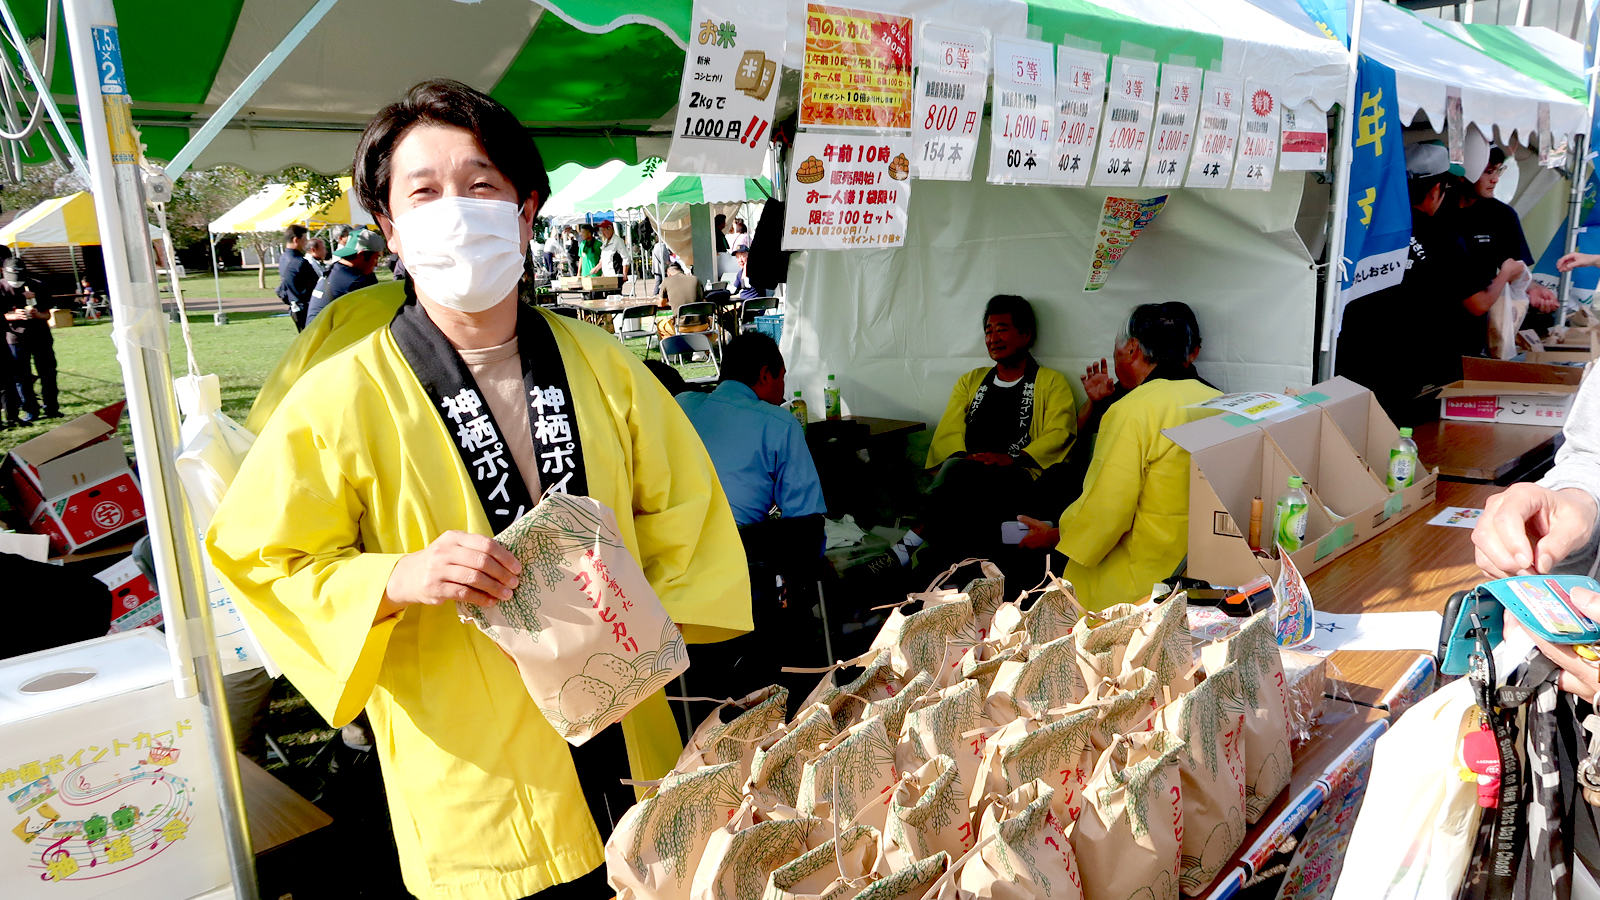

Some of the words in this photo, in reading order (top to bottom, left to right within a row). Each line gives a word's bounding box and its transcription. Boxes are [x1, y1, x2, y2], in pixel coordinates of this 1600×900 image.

[698, 19, 737, 49] お米
[808, 15, 870, 40] 旬のみかん
[890, 24, 906, 46] なんと
[697, 56, 710, 65] 新米
[945, 47, 970, 70] 6等
[694, 72, 722, 82] コシヒカリ
[1016, 60, 1038, 81] 5等
[1073, 71, 1092, 90] 4等
[1125, 79, 1143, 98] 3等
[1174, 85, 1190, 102] 2等
[689, 92, 726, 109] 2kgで
[924, 104, 958, 131] 800
[962, 111, 977, 134] 円
[1003, 114, 1036, 142] 1,600
[1039, 119, 1050, 141] 円
[1058, 120, 1085, 147] 2,400
[1085, 126, 1095, 147] 円
[1109, 127, 1136, 152] 4,000
[1134, 131, 1145, 150] 円
[1158, 130, 1182, 154] 8,000
[1180, 133, 1189, 152] 円
[823, 143, 890, 163] 午前10時
[924, 141, 946, 162] 154
[948, 143, 963, 164] 本
[1201, 134, 1227, 157] 16,000
[1225, 138, 1233, 155] 円
[1007, 149, 1021, 167] 60
[1024, 150, 1037, 170] 本
[1058, 154, 1069, 171] 40
[1070, 154, 1081, 173] 本
[1107, 158, 1119, 174] 30
[1121, 158, 1132, 176] 本
[1157, 159, 1166, 175] 10
[1167, 160, 1177, 176] 本
[830, 170, 882, 185] 販売開始!
[1203, 163, 1210, 177] 4
[1210, 162, 1220, 178] 本
[1247, 165, 1253, 178] 2
[1254, 163, 1263, 179] 本
[806, 189, 897, 205] お一人様1袋限り
[808, 209, 893, 225] 限定100セット
[1020, 382, 1034, 427] 神栖ポイント
[573, 571, 639, 653] コシヒカリ
[1501, 690, 1514, 701] on
[1500, 738, 1517, 774] Sunrise
[1501, 804, 1518, 825] Years
[1498, 826, 1516, 840] Day
